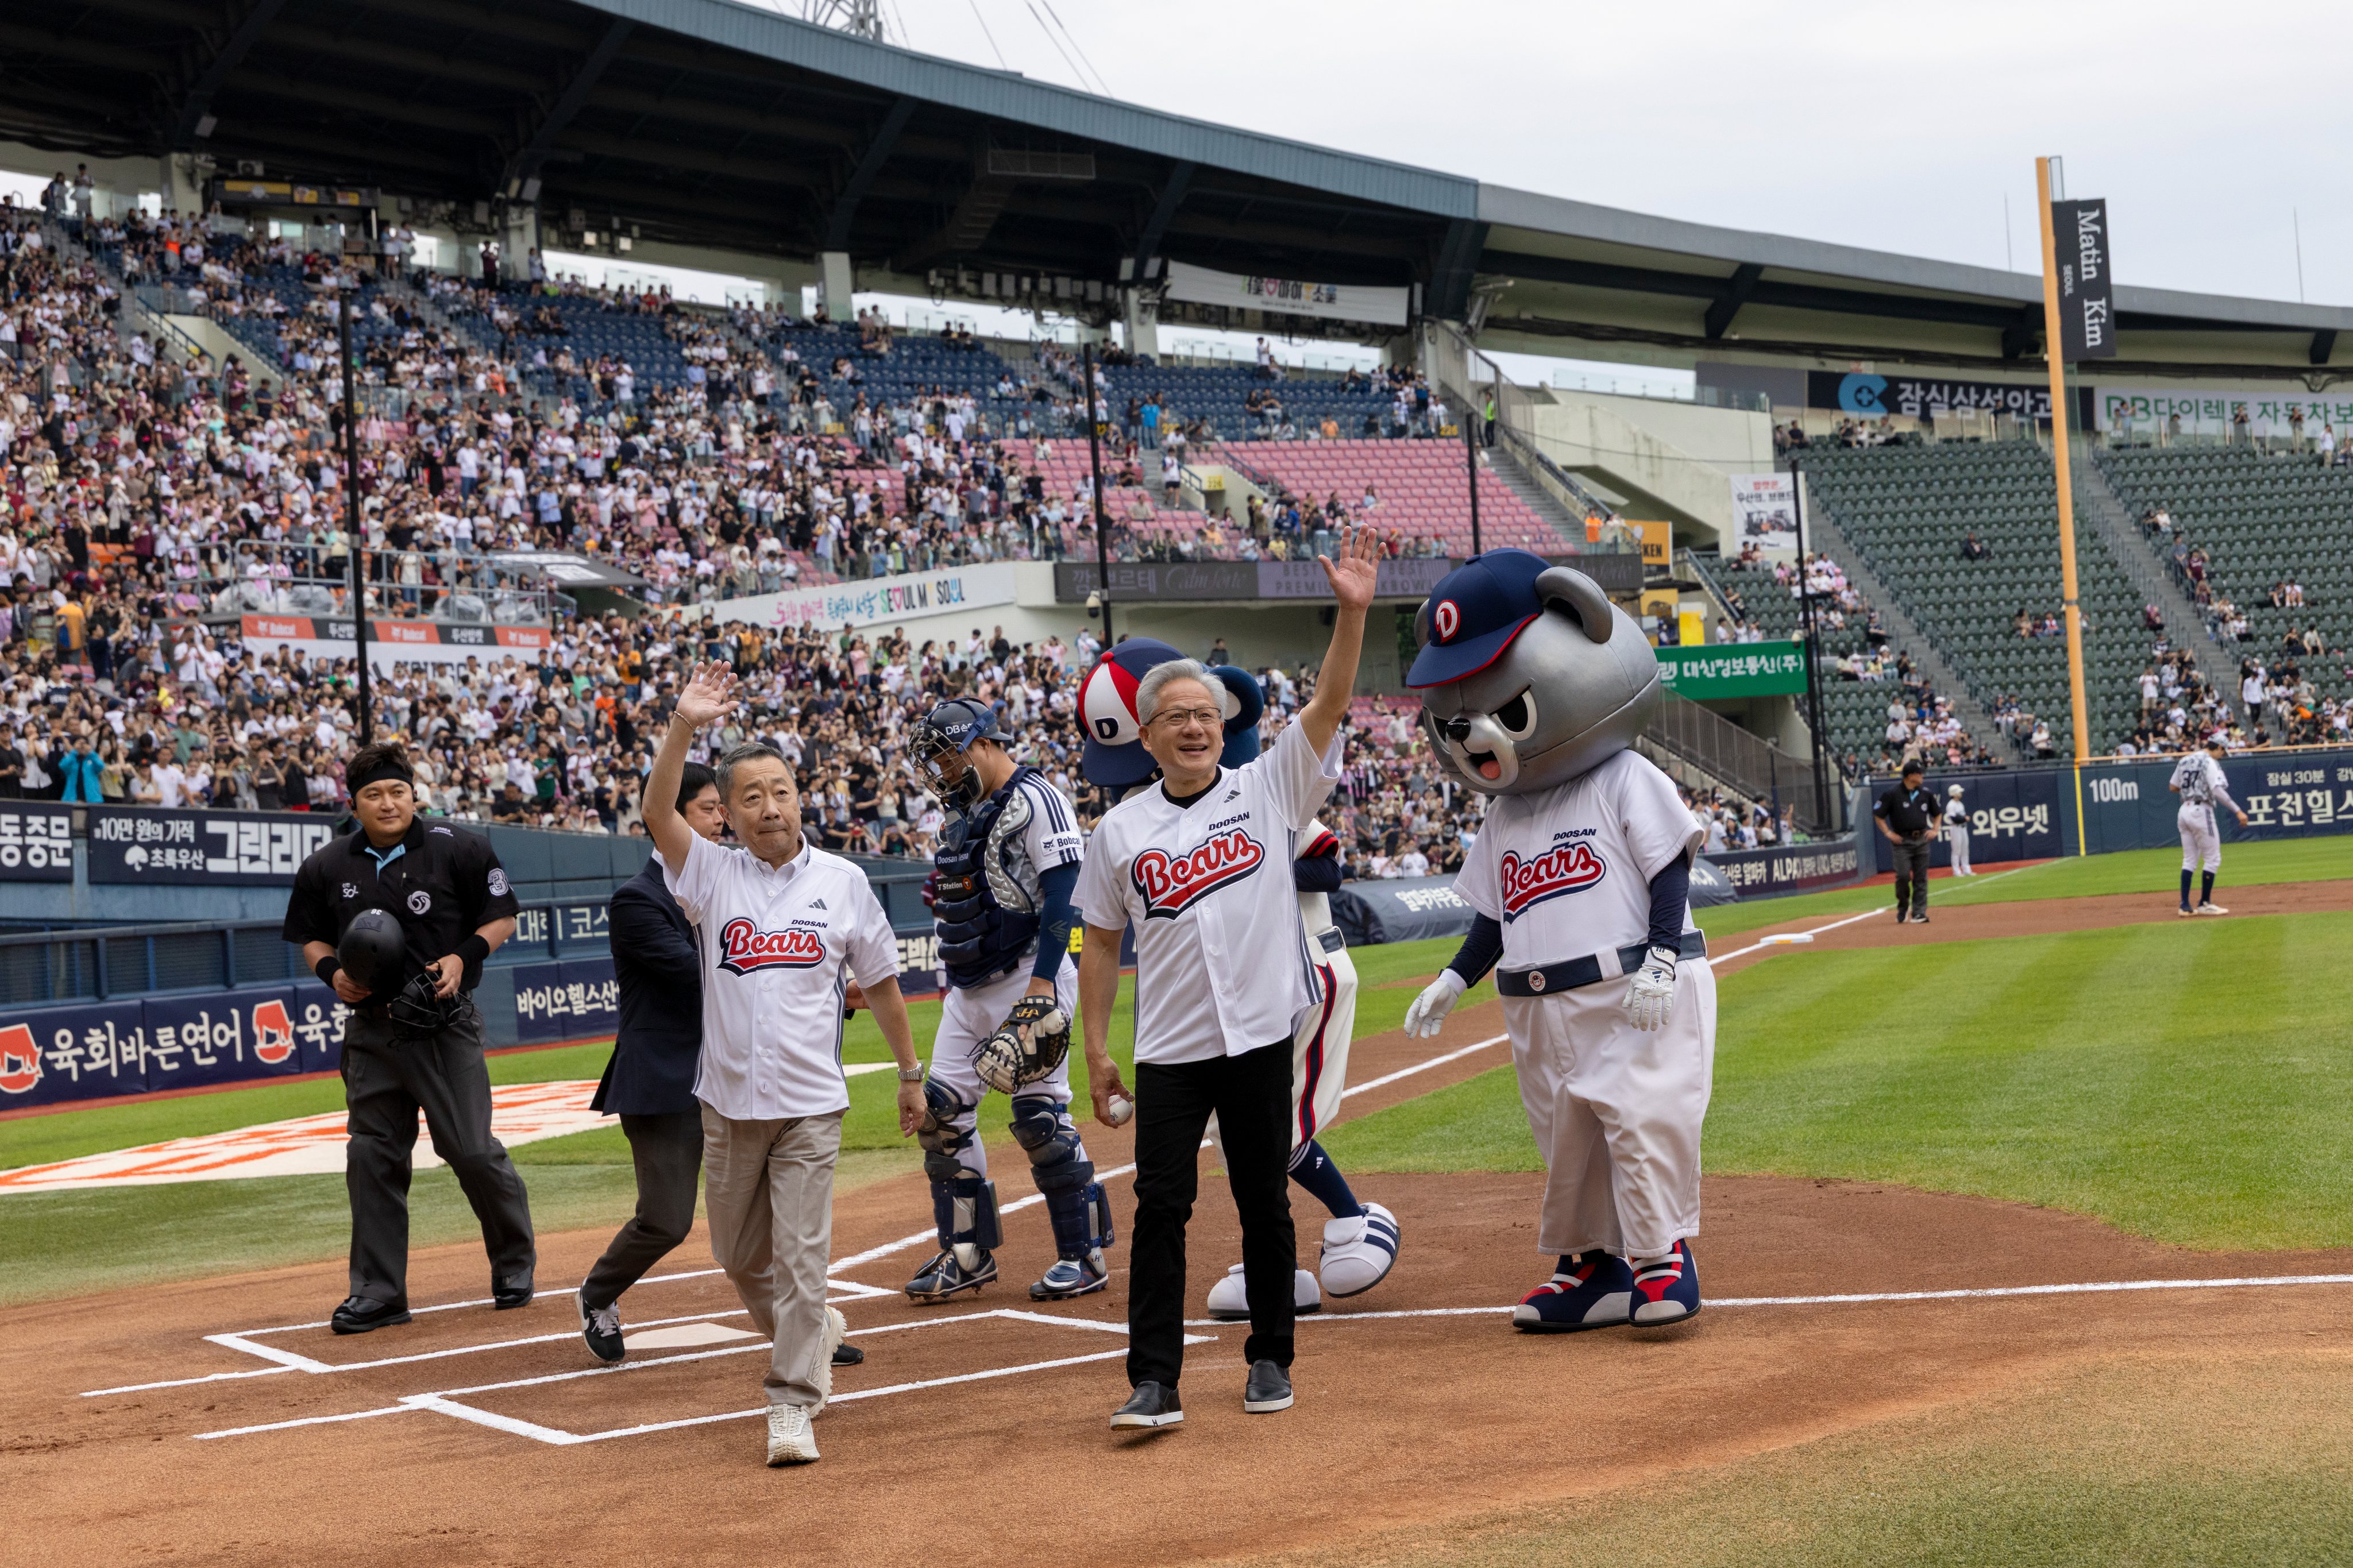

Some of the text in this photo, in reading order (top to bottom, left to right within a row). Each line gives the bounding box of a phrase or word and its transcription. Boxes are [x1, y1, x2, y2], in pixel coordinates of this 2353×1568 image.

[2078, 208, 2107, 348] Matin Kim
[1683, 654, 1804, 678] 대신정보통신(주)
[1095, 717, 1119, 739] D
[2089, 777, 2139, 803] 100m
[2182, 770, 2199, 789] 37
[1208, 812, 1250, 831] DOOSAN
[1553, 828, 1597, 841] DOOSAN
[1972, 804, 2049, 839] 와우넷
[150, 848, 205, 871] 초록우산
[938, 856, 958, 864] Doosan
[1133, 829, 1263, 914] Bears
[488, 868, 514, 896] 3
[1501, 843, 1604, 918] Bears
[791, 919, 828, 929] DOOSAN
[720, 918, 826, 972] Bears
[516, 980, 619, 1019] 바이오헬스산
[45, 1008, 242, 1082] 육회바른연어
